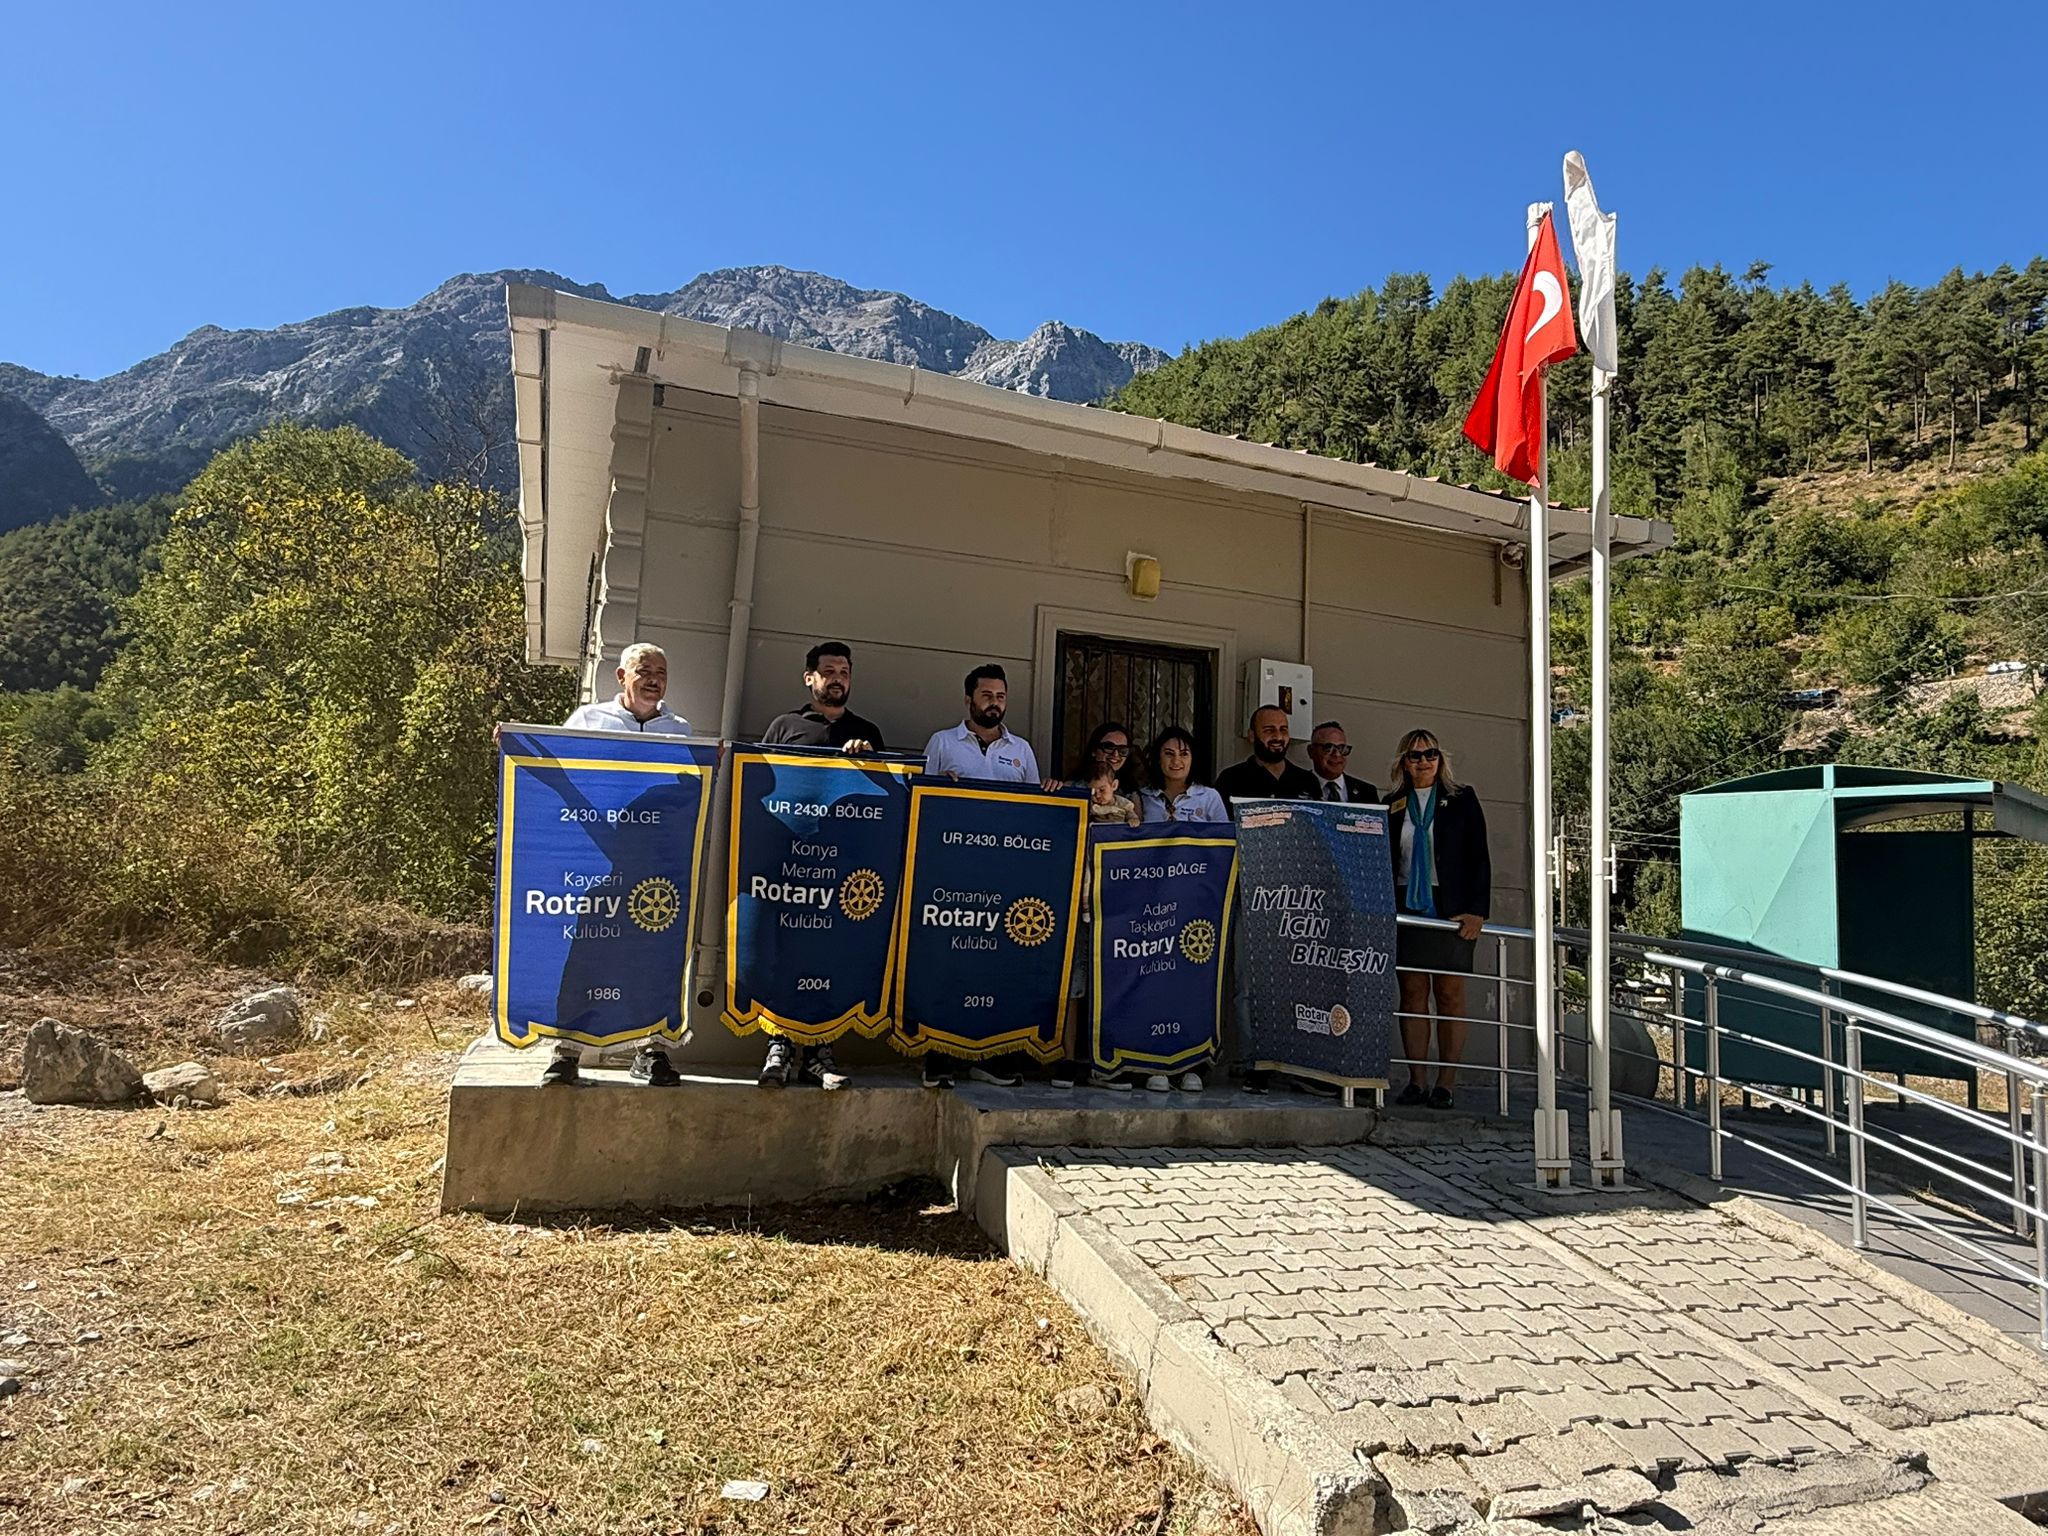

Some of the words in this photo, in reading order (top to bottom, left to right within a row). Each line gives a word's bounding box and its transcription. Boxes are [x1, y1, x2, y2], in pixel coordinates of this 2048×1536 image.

[560, 808, 602, 823] 2430.
[606, 807, 661, 824] BÖLGE
[768, 800, 791, 815] UR
[794, 802, 832, 818] 2430.
[835, 803, 883, 820] BÖLGE
[791, 840, 838, 861] Konya
[942, 831, 963, 845] UR
[965, 833, 1000, 848] 2430.
[1003, 834, 1051, 851] BÖLGE
[563, 870, 624, 891] Kayseri
[782, 862, 836, 880] Meram
[1110, 868, 1130, 881] UR
[1133, 866, 1164, 880] 2430
[1167, 862, 1207, 877] BÖLGE
[751, 875, 834, 909] Rotary
[932, 887, 1002, 907] Osmaniye
[1251, 885, 1325, 911] İYİLİK
[525, 889, 622, 918] Rotary
[1143, 902, 1177, 916] Adana
[779, 912, 833, 930] Kulübü
[922, 904, 1000, 931] Rotary
[1129, 916, 1176, 935] Taşköprü
[1279, 911, 1330, 939] İÇİN
[562, 923, 621, 939] Kulübü
[951, 935, 998, 951] Kulübü
[1113, 934, 1175, 959] Rotary
[1291, 941, 1389, 974] BİRLEŞİN
[1139, 958, 1177, 977] Kulübü
[797, 977, 830, 991] 2004
[586, 987, 621, 1001] 1986
[964, 995, 994, 1008] 2019
[1151, 1022, 1181, 1036] 2019
